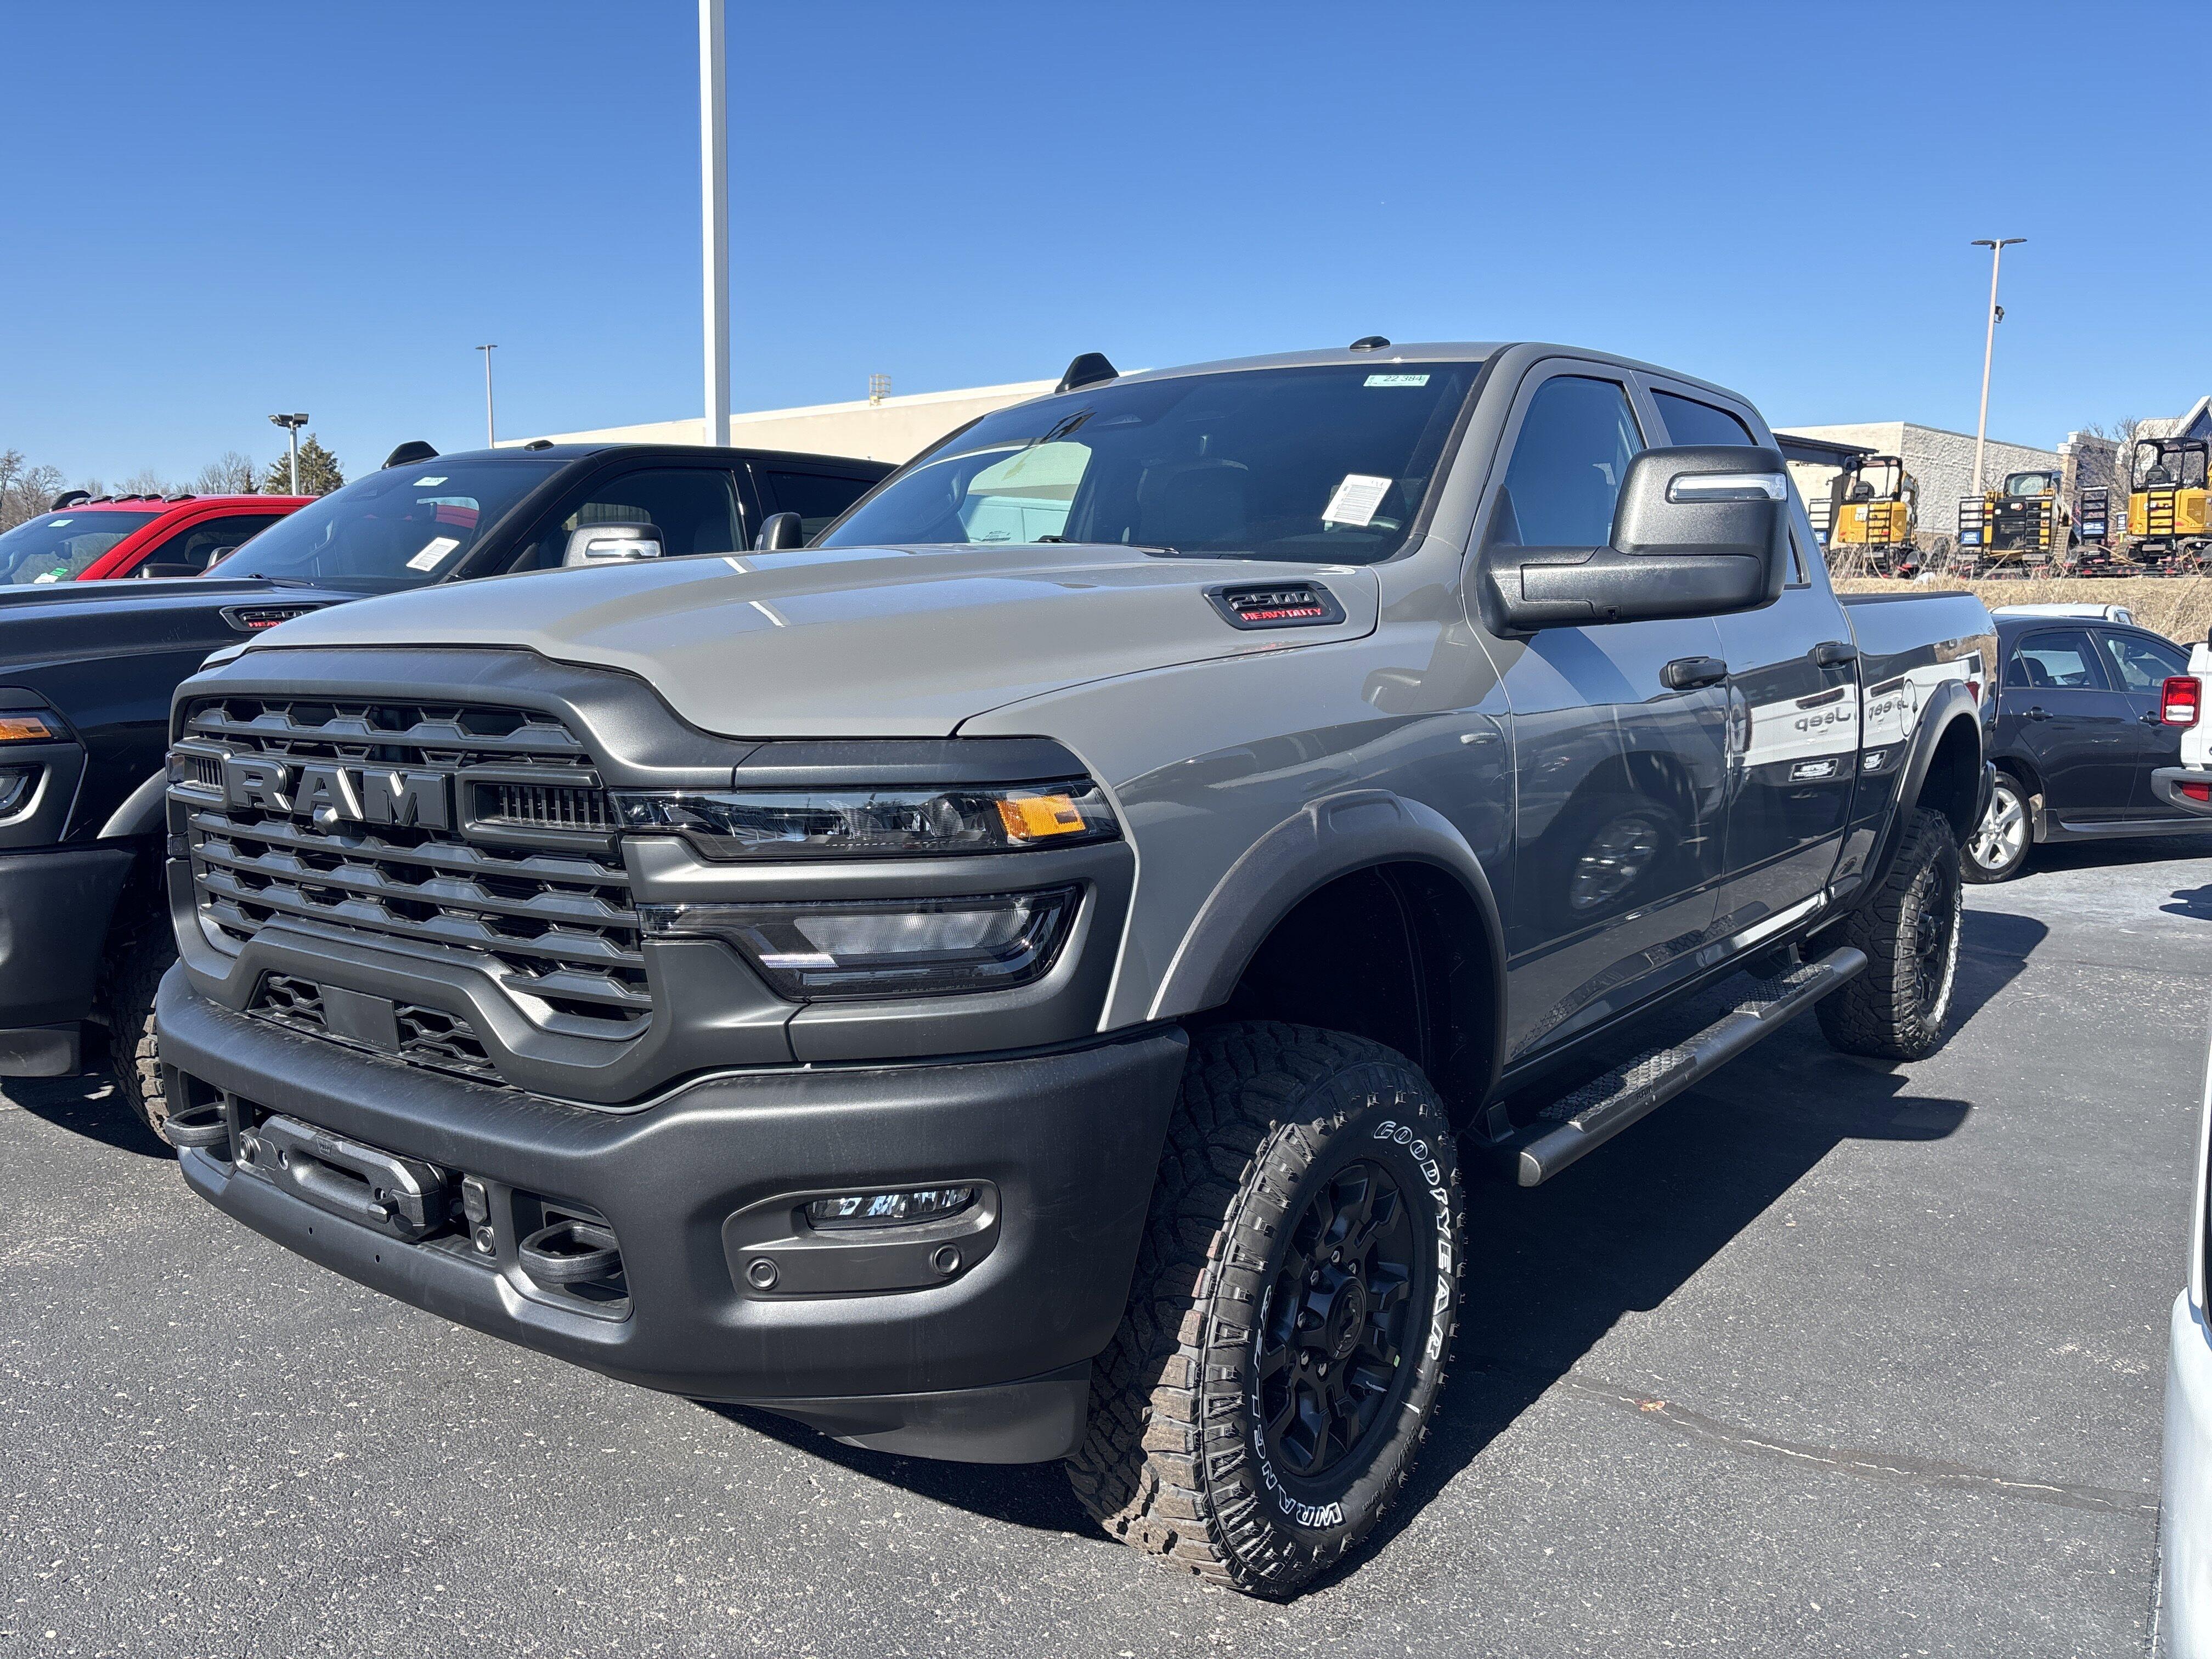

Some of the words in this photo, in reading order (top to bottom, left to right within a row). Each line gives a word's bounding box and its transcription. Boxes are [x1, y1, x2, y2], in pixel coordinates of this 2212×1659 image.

[1228, 592, 1315, 611] 2500
[1241, 610, 1286, 621] HEAVY
[1286, 607, 1322, 618] DUTY
[227, 757, 449, 831] RAM
[1373, 1120, 1452, 1361] GOODYEAR
[1252, 1284, 1343, 1527] WRANGLER
